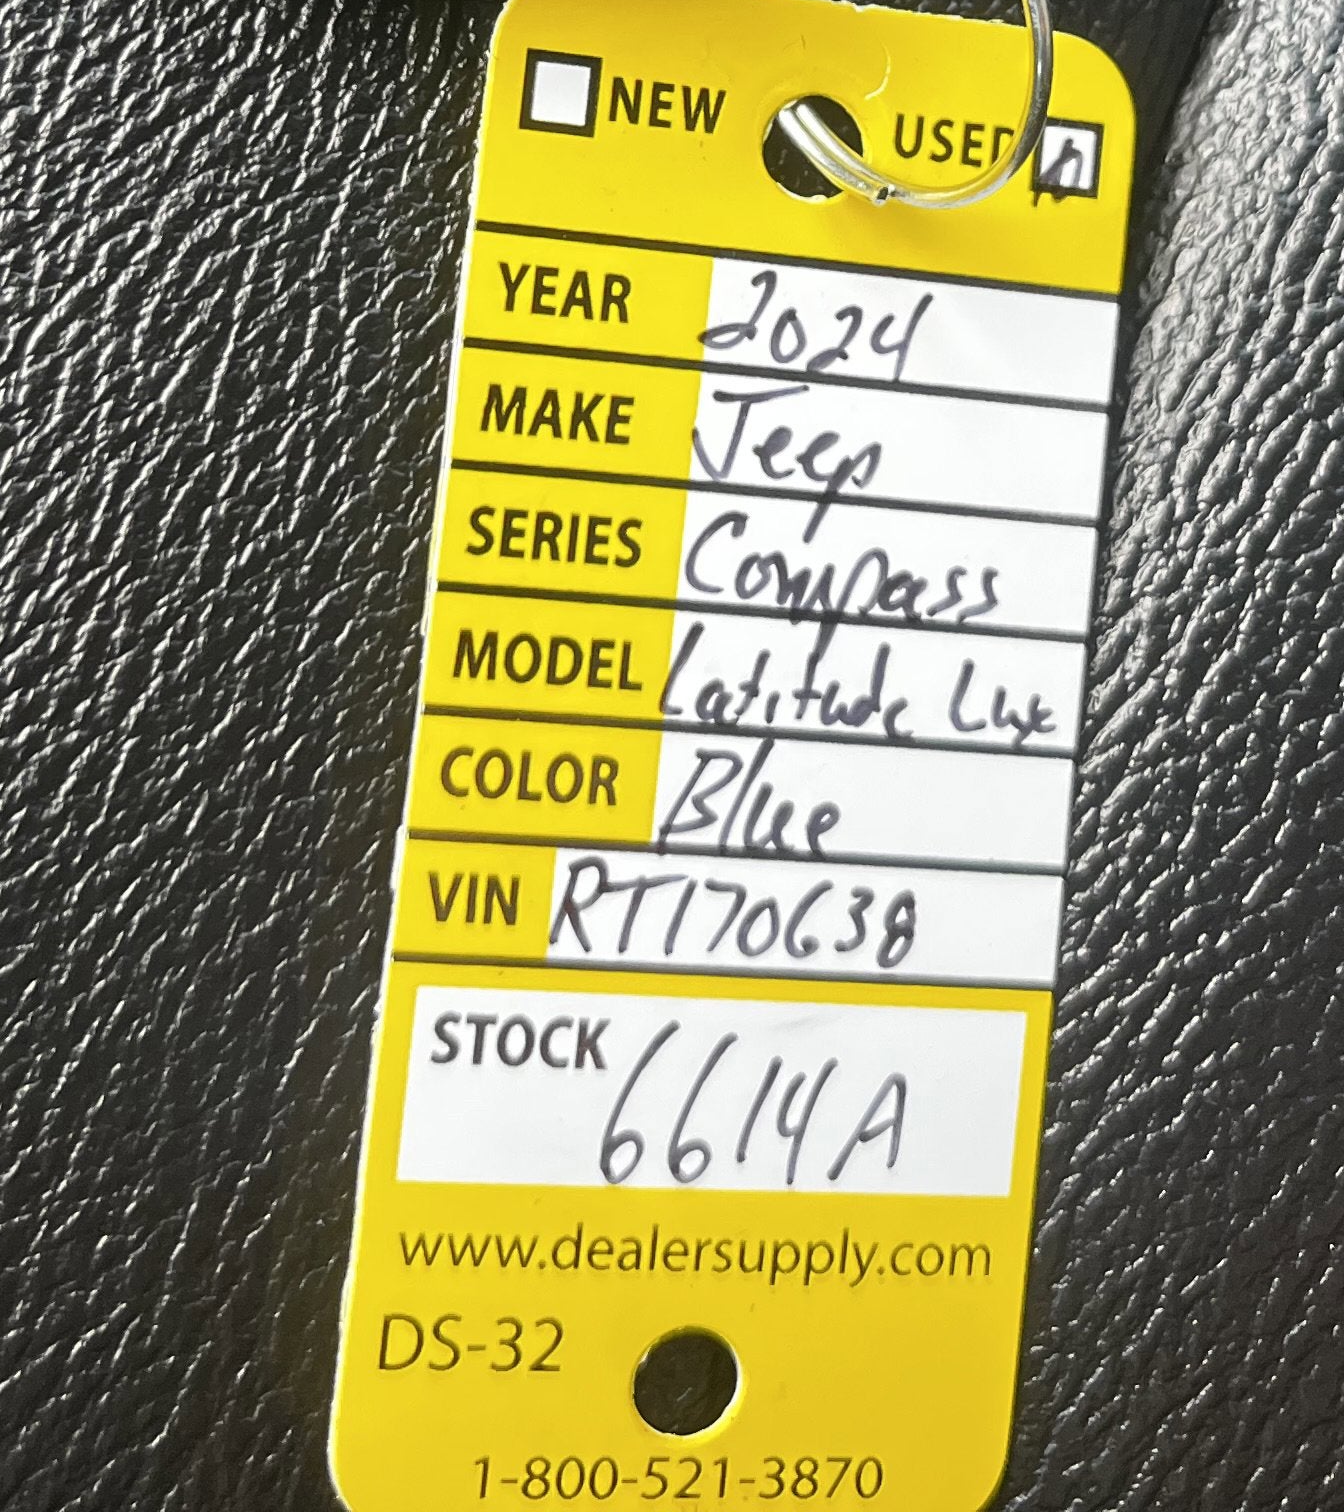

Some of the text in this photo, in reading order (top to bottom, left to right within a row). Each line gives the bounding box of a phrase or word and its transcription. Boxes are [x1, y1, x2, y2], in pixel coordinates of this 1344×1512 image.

[607, 76, 727, 135] NEW
[499, 262, 631, 325] YEAR
[698, 270, 934, 381] 2024
[479, 384, 635, 445] MAKE
[691, 385, 885, 544] Jeep
[466, 505, 644, 568] SERIES
[684, 511, 1001, 654] Compass
[452, 628, 643, 692] MODEL
[658, 622, 1058, 747] Latitude Lux
[440, 747, 619, 807] COLOR
[657, 738, 842, 857] Blue
[429, 871, 522, 926] VIN
[549, 856, 918, 968] RT170638
[430, 1009, 612, 1071] STOCK
[599, 1019, 908, 1185] 6614A
[398, 1222, 993, 1287] www.dealersupply.com
[378, 1312, 565, 1373] DS-32
[474, 1455, 885, 1499] 1-800-521-3870
